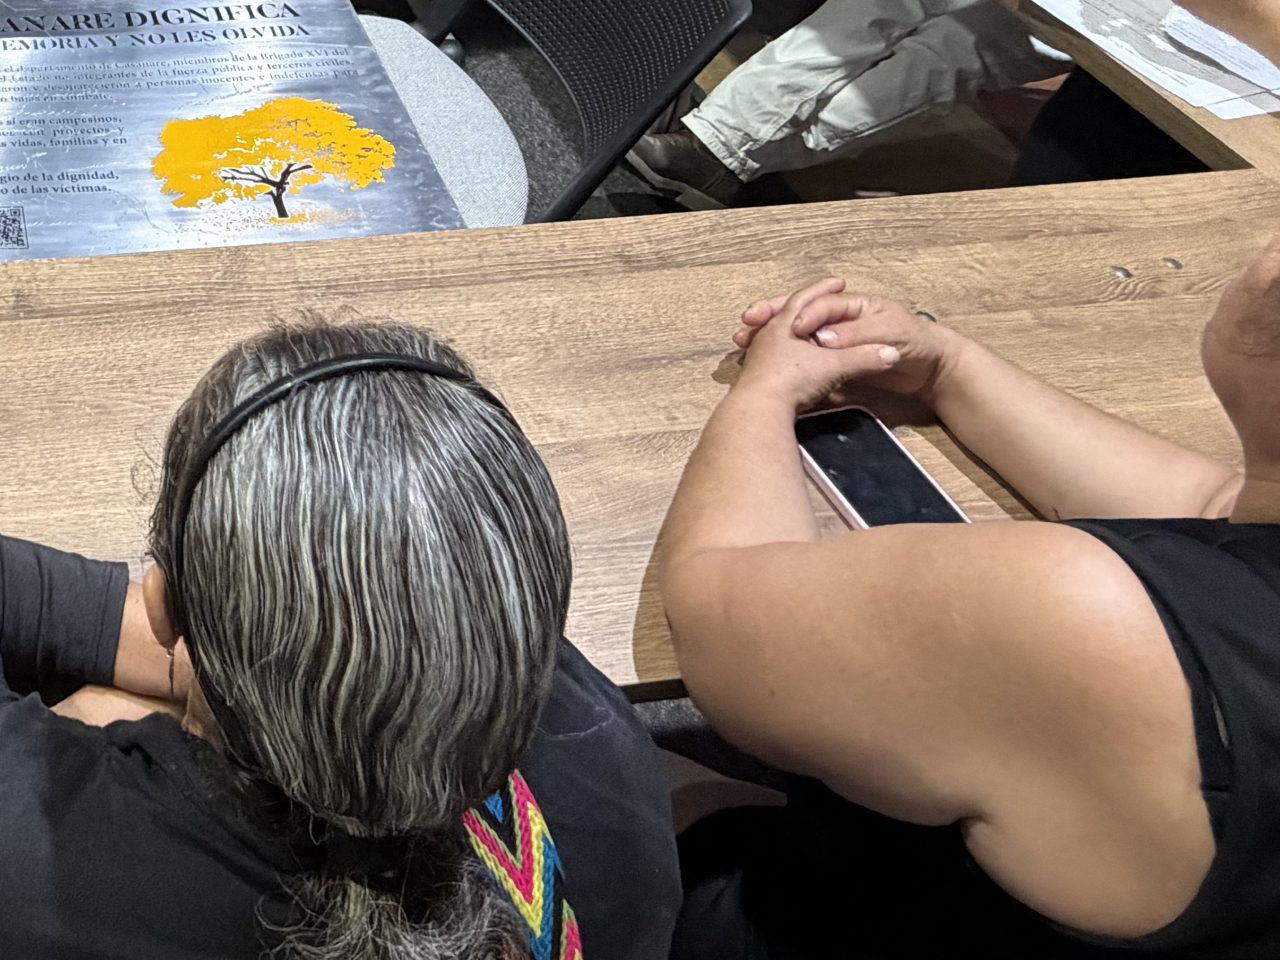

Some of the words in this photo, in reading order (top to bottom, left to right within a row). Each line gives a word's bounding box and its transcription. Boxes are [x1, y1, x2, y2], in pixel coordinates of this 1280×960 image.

[124, 2, 303, 27] DIGNIFICA
[104, 34, 119, 48] Y
[129, 32, 166, 47] NO
[171, 29, 217, 44] LES
[222, 24, 311, 41] OLVIDA
[173, 67, 208, 76] fuerza
[267, 61, 312, 70] terceros
[146, 78, 197, 89] personas
[49, 115, 123, 127] campesinos,
[52, 126, 111, 138] proyectos
[10, 137, 47, 148] vidas,
[50, 136, 99, 147] familias
[113, 136, 128, 145] en
[23, 172, 39, 183] de
[41, 171, 54, 182] la
[57, 170, 120, 184] dignidad,
[12, 184, 27, 195] de
[31, 184, 50, 194] las
[51, 183, 112, 194] víctimas.
